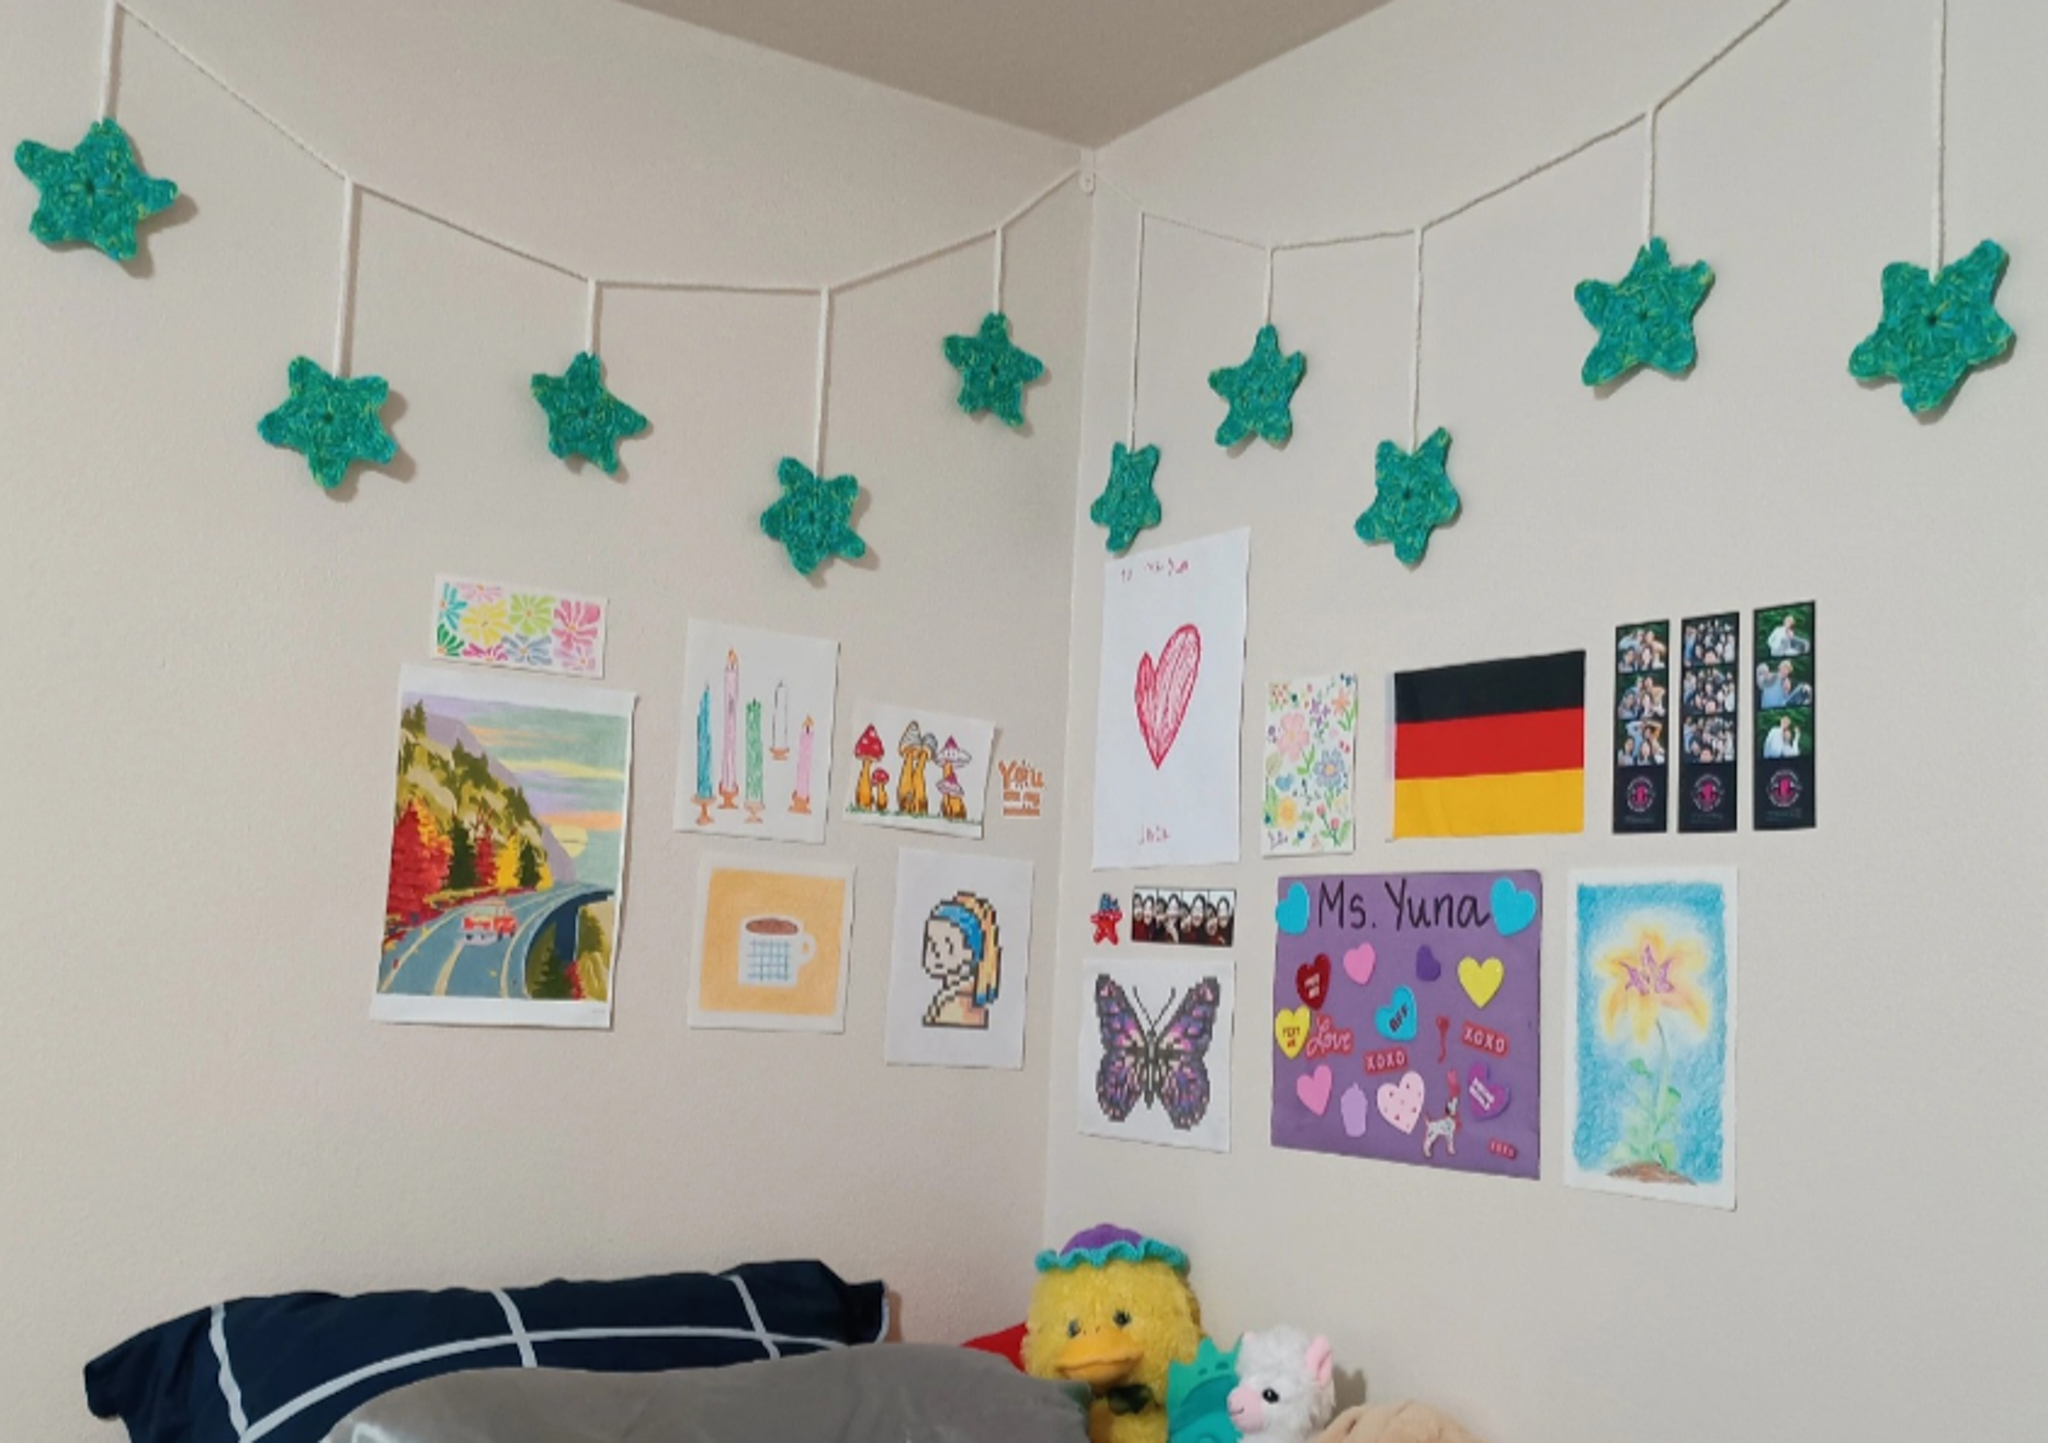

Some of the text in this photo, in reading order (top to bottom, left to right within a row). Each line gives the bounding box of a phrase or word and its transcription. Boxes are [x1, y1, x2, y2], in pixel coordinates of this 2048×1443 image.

[1318, 878, 1491, 931] Ms. Yuna
[1306, 1015, 1352, 1058] Love
[1464, 1027, 1505, 1053] XOXO
[1365, 1050, 1405, 1071] XOXO
